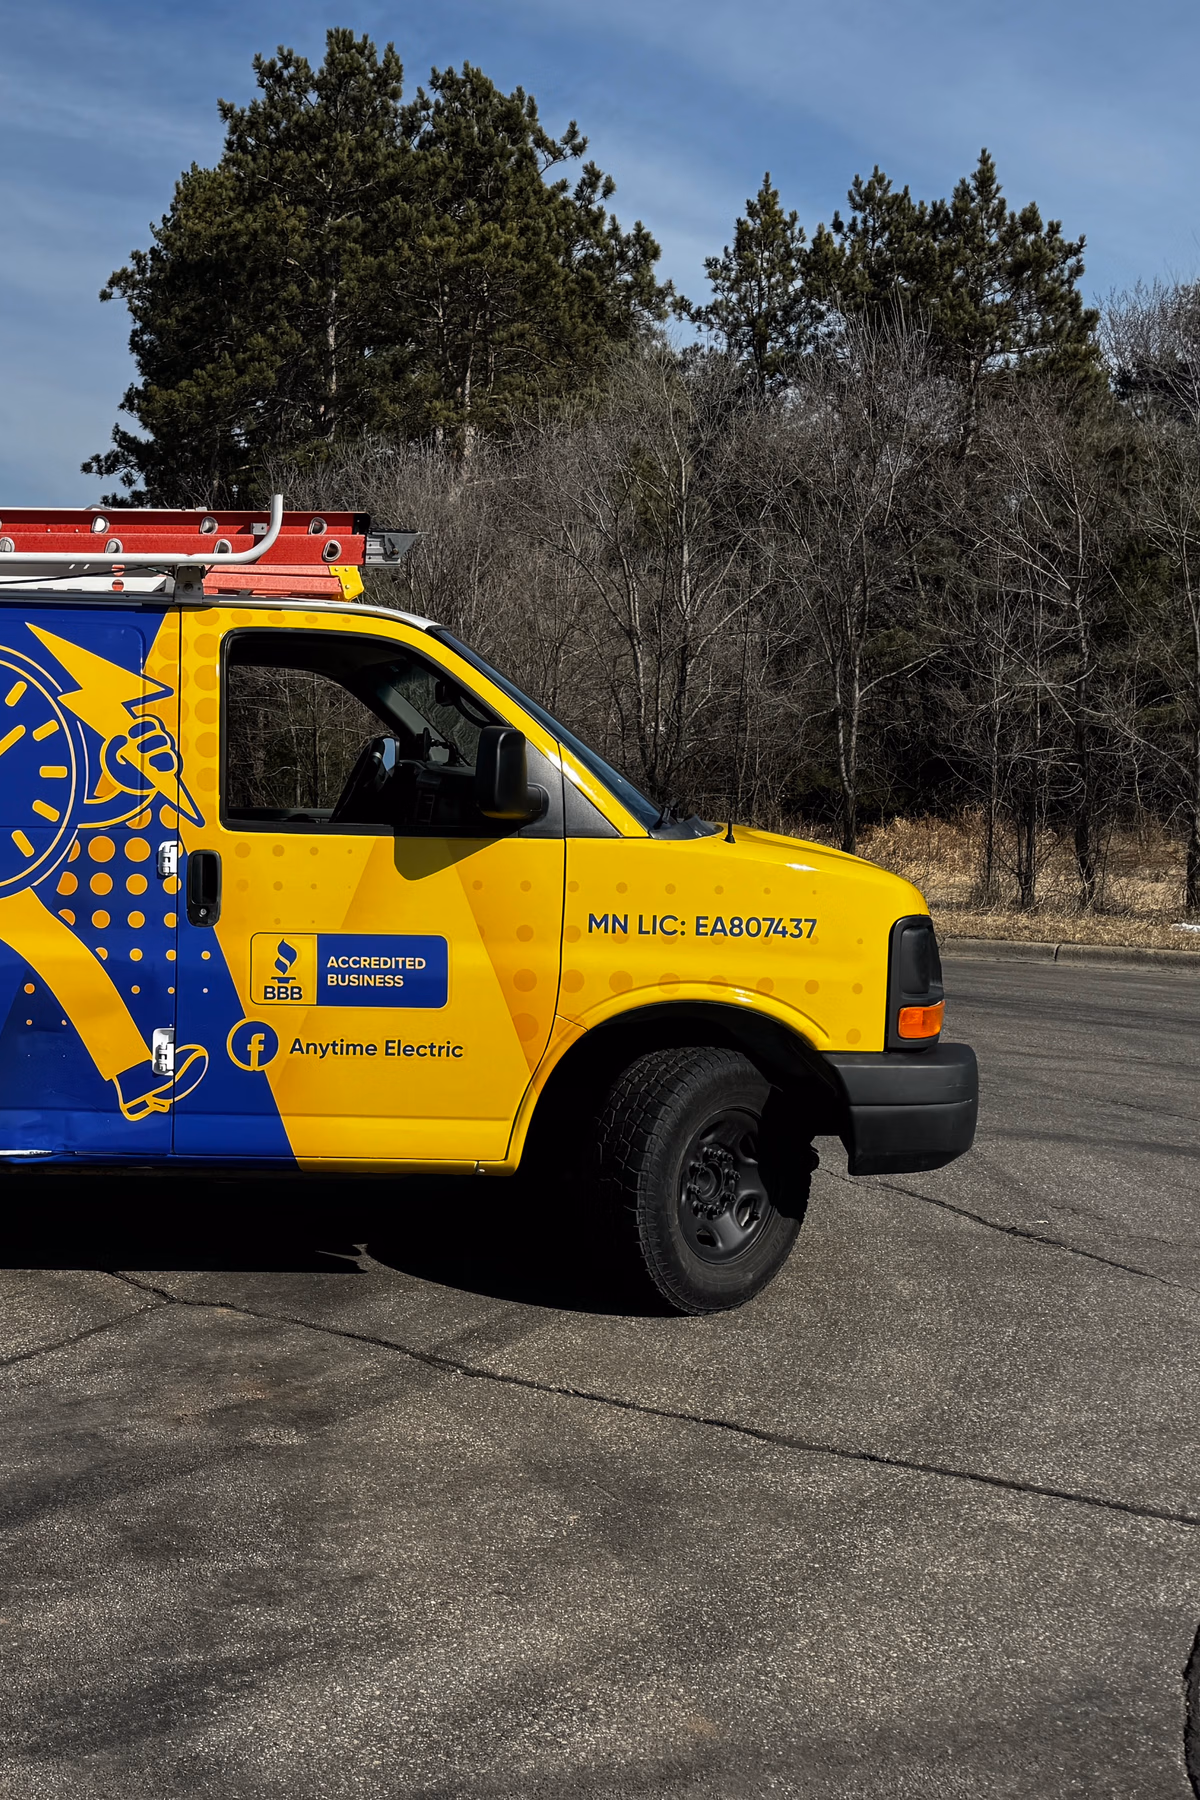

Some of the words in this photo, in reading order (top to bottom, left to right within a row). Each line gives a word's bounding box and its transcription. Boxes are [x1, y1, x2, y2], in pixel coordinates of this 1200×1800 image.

[588, 913, 629, 935] MN
[638, 914, 686, 936] LIC:
[695, 916, 818, 939] EA807437
[327, 956, 427, 970] ACCREDITED
[327, 974, 405, 988] BUSINESS
[263, 985, 304, 1001] BBB
[289, 1038, 378, 1060] Anytime
[384, 1039, 464, 1059] Electric
